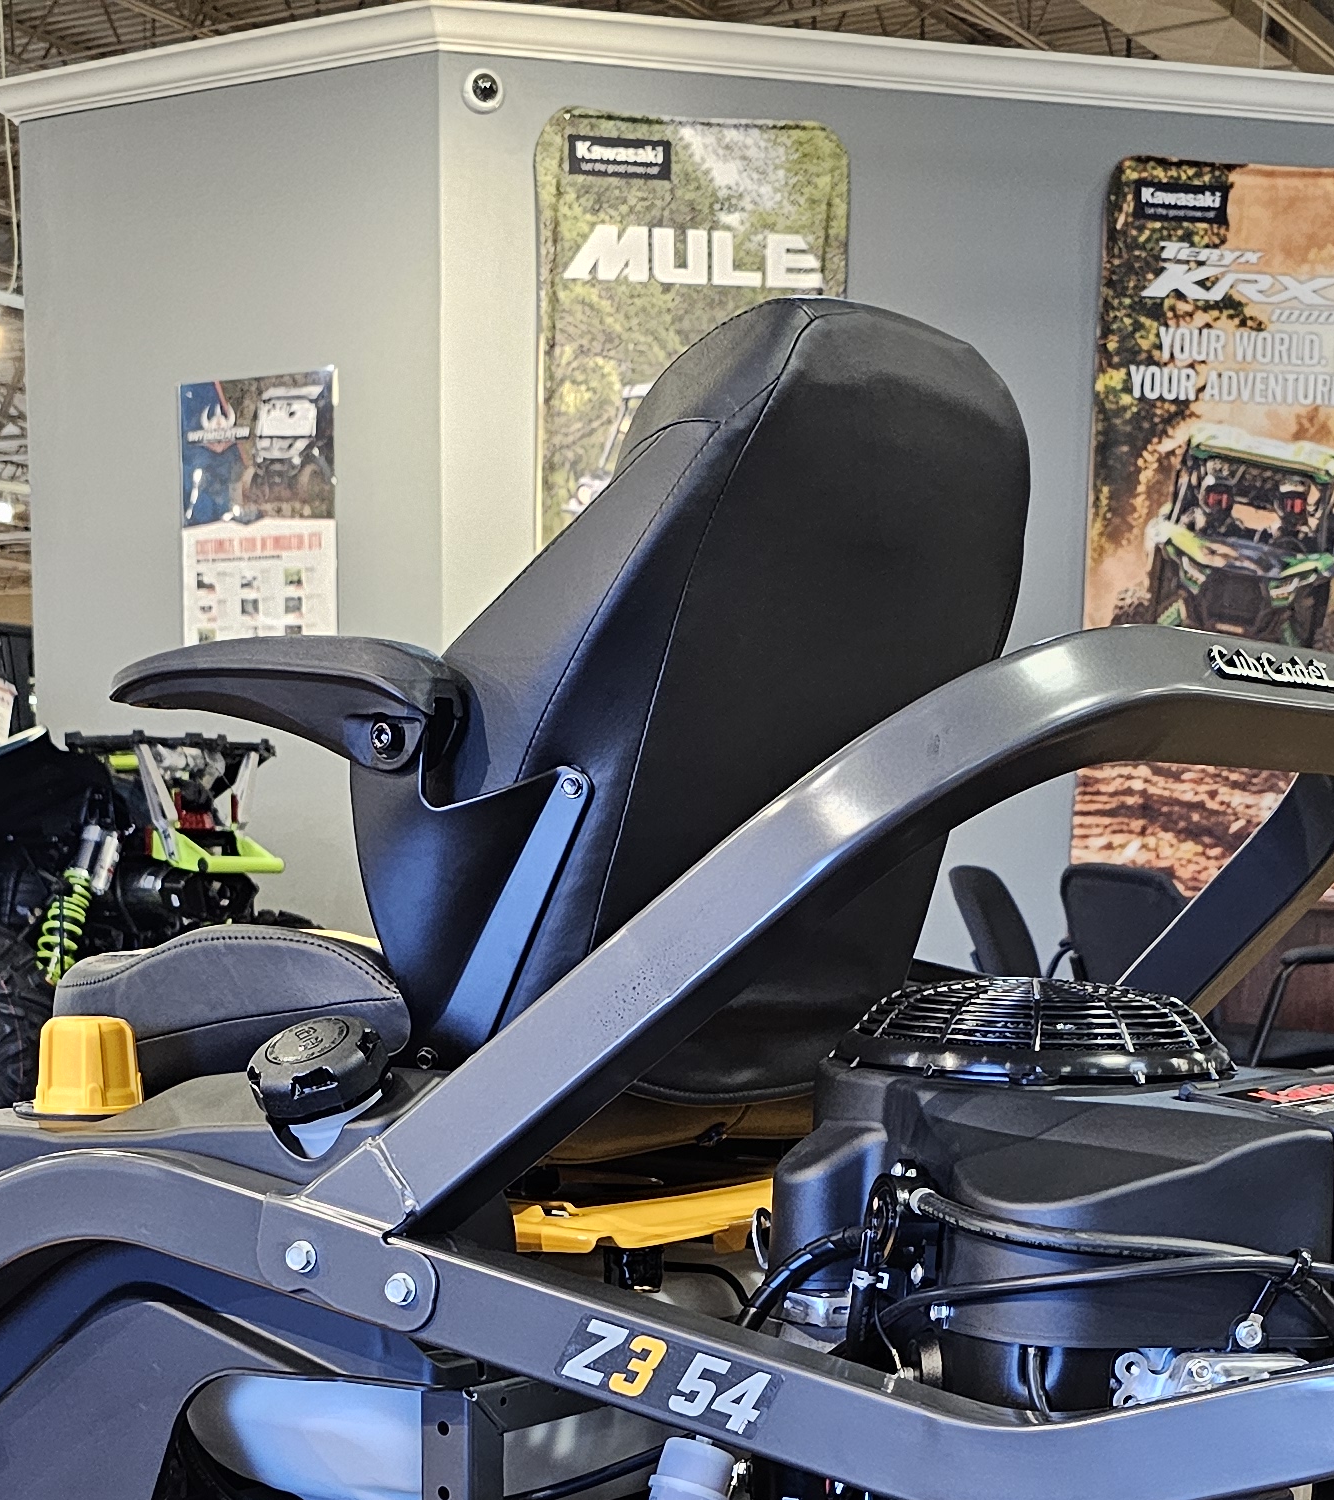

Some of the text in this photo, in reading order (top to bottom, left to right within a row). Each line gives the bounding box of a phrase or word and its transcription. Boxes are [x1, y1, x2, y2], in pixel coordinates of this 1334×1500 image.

[575, 140, 664, 165] Kawasaki
[1141, 186, 1222, 208] Kawasaki
[564, 224, 825, 289] MULE
[1159, 326, 1327, 367] YOUR WORLD.
[1129, 364, 1197, 401] YOUR
[1212, 645, 1264, 679] Cub
[560, 1318, 772, 1434] Z3 54
